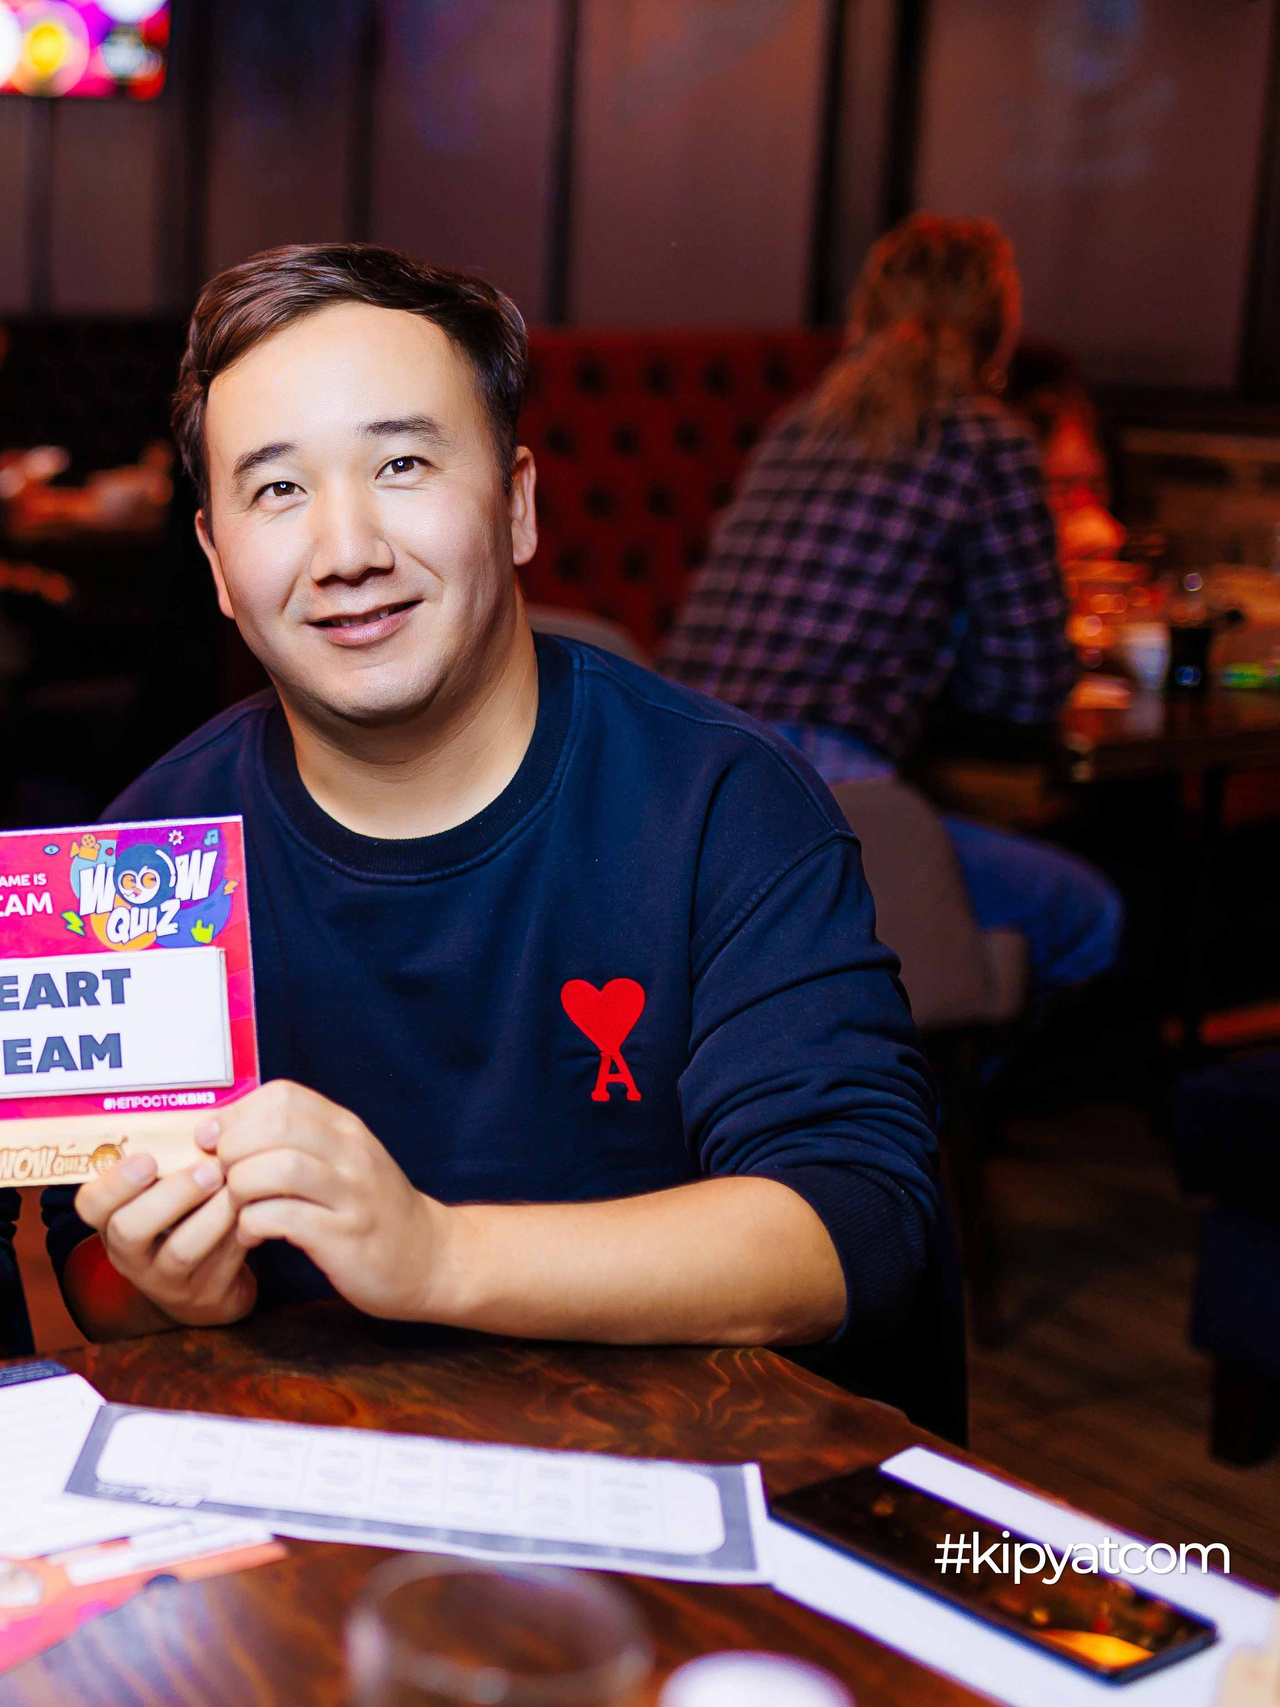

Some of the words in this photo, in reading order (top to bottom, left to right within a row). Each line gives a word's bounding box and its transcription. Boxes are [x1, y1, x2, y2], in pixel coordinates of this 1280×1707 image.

[33, 873, 47, 886] IS
[79, 848, 218, 916] WOW
[106, 898, 181, 945] QUIZ
[103, 1091, 216, 1110] #НЕПРОСТОКВИЗ
